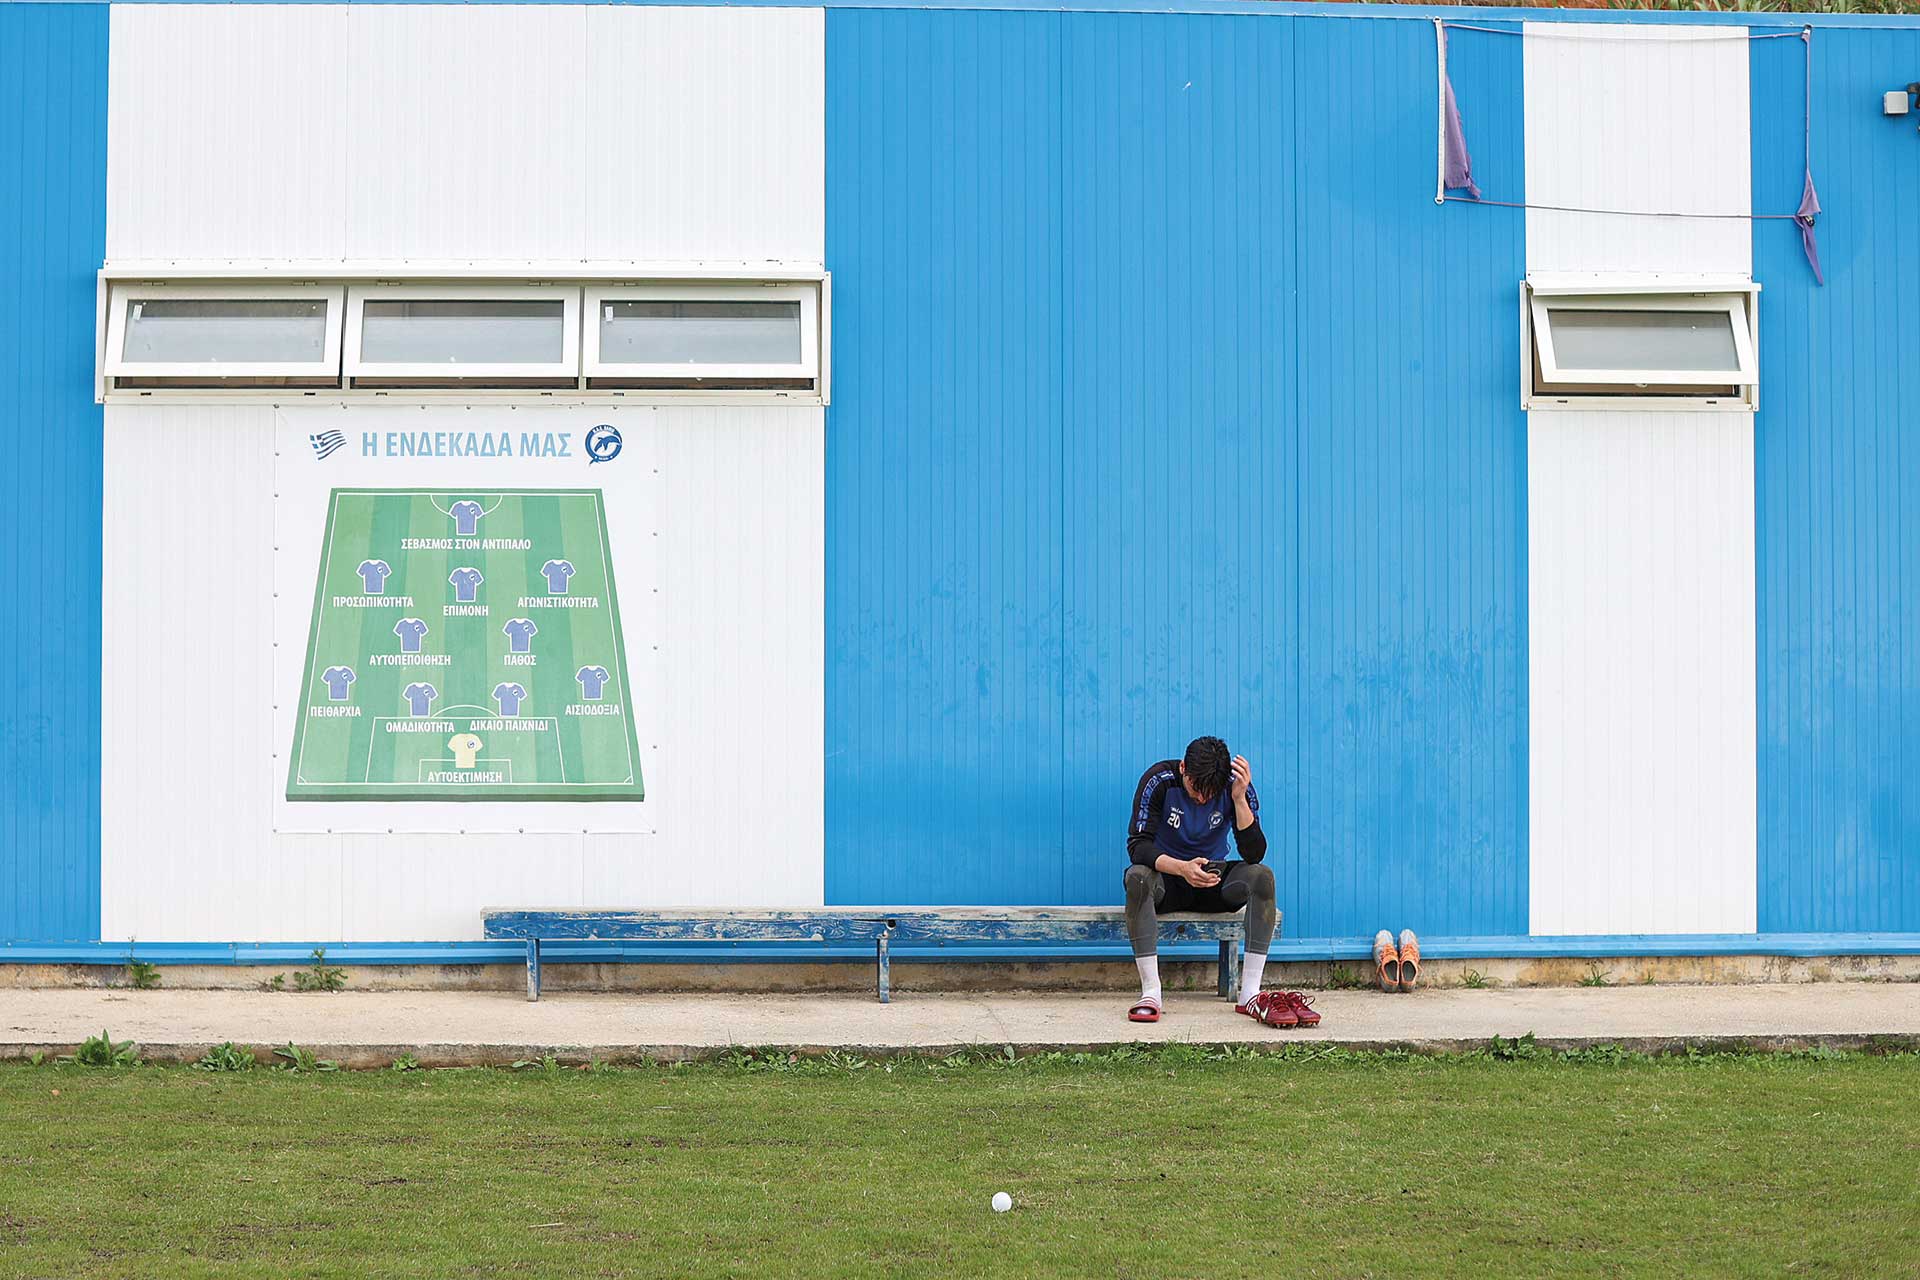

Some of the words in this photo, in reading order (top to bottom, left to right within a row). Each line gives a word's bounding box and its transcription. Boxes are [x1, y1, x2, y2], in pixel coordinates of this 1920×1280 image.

[362, 431, 378, 457] Η
[386, 431, 513, 457] ΕΝΔΕΚΑΔΑ
[520, 432, 572, 458] ΜΑΣ
[401, 538, 454, 550] ΣΕΒΑΣΜΟΣ
[454, 538, 481, 550] ΣΤΟΝ
[482, 538, 531, 550] ΑΝΤΙΠΑΛΟ
[333, 596, 414, 608] ΠΡΟΣΩΠΙΚΟΤΗΤΑ
[517, 596, 599, 608] ΑΓΩΝΙΣΤΙΚΟΤΗΤΑ
[443, 605, 489, 617] ΕΠΙΜΟΝΗ
[369, 654, 451, 666] ΑΥΤΟΠΕΠΟΙΘΗΣΗ
[503, 654, 537, 666] ΠΑΘΟΣ
[310, 705, 361, 717] ΠΕΙΘΑΡΧΙΑ
[565, 704, 620, 716] ΑΙΣΙΟΔΟΞΙΑ
[385, 721, 455, 733] ΟΜΑΔΙΚΟΤΗΤΑ
[469, 720, 503, 732] ΔΙΚΑΙΟ
[505, 719, 548, 732] ΠΑΙΧΝΙΔΙ
[427, 771, 502, 783] ΑΥΤΟΕΚΤΙΜΗΣΗ
[1167, 812, 1181, 829] 20
